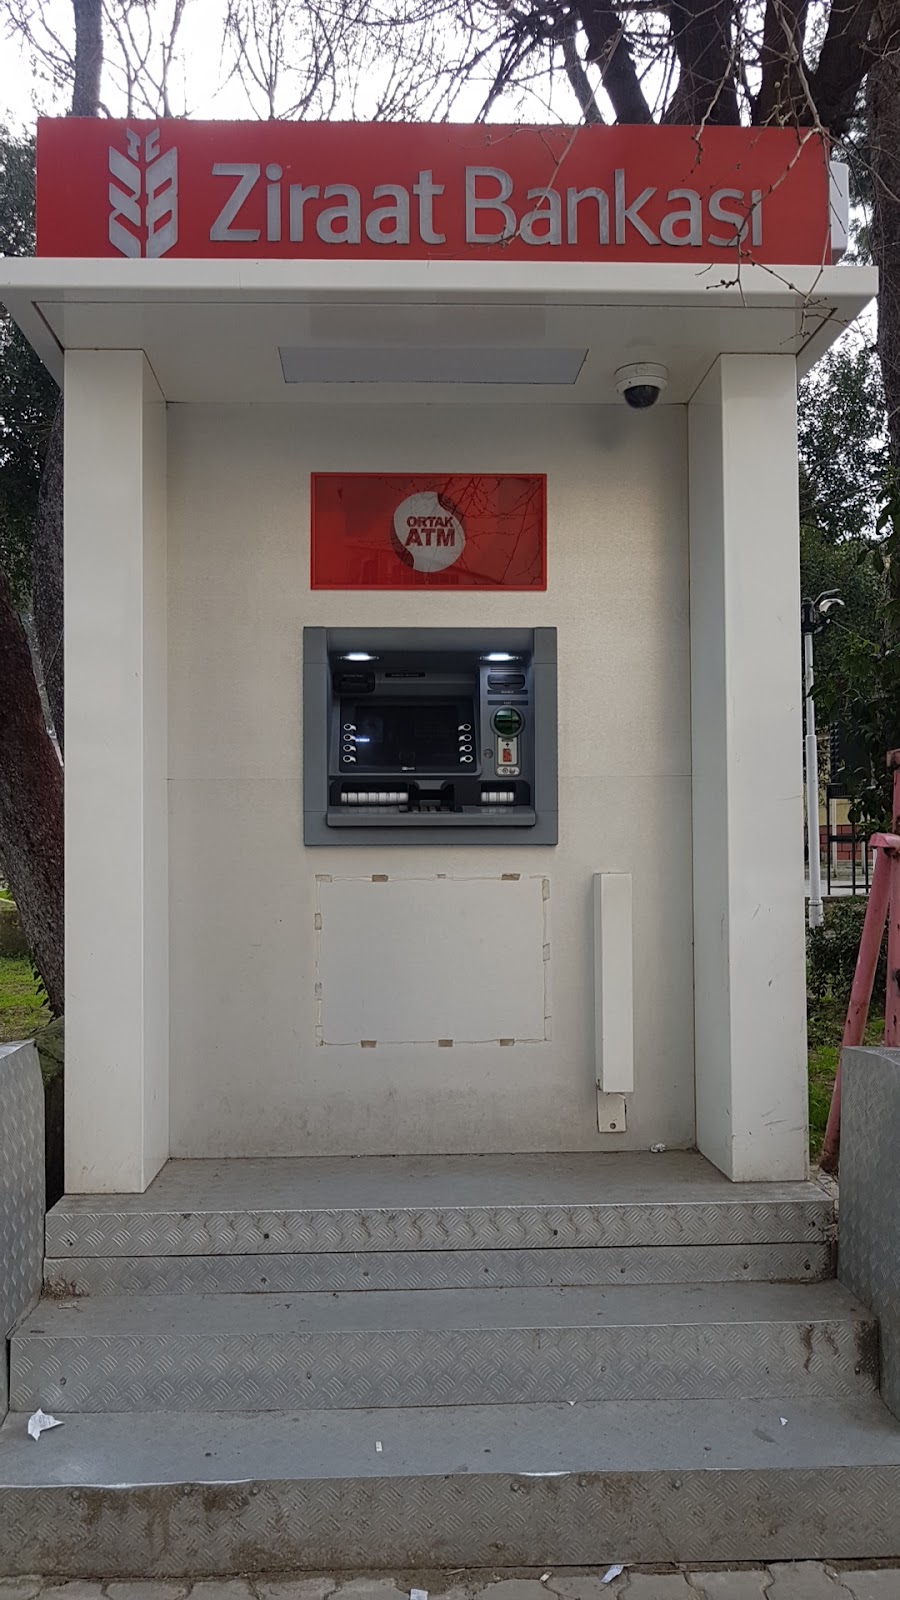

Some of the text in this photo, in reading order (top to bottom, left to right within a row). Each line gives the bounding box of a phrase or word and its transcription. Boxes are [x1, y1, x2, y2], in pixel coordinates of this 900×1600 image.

[209, 163, 763, 247] Ziraat Bankası
[406, 516, 454, 528] ORTAK
[405, 528, 455, 547] ATM
